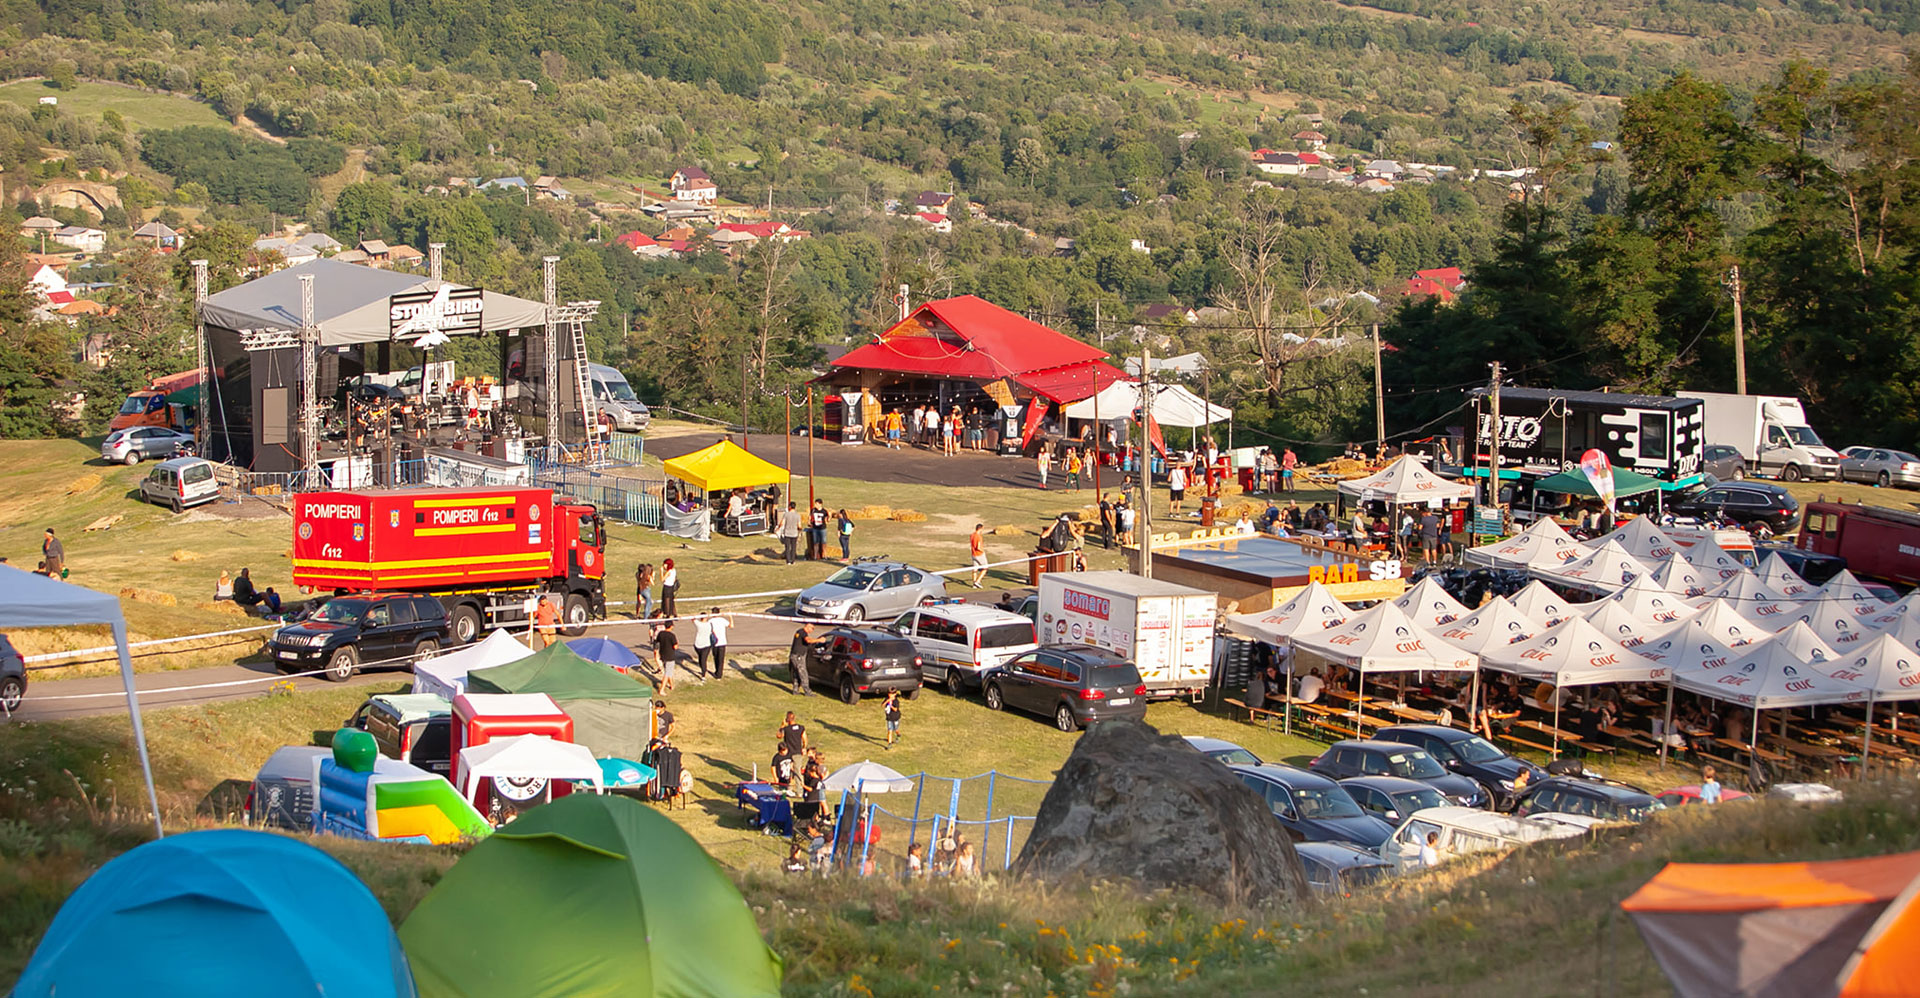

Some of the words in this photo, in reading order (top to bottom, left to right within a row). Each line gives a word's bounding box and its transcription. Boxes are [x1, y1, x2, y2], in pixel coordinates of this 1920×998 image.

[305, 504, 361, 519] POMPIERII
[434, 508, 478, 524] POMPIERII
[487, 511, 499, 522] 112
[328, 548, 342, 558] 112
[1309, 563, 1359, 585] BAR
[1370, 560, 1402, 581] SB
